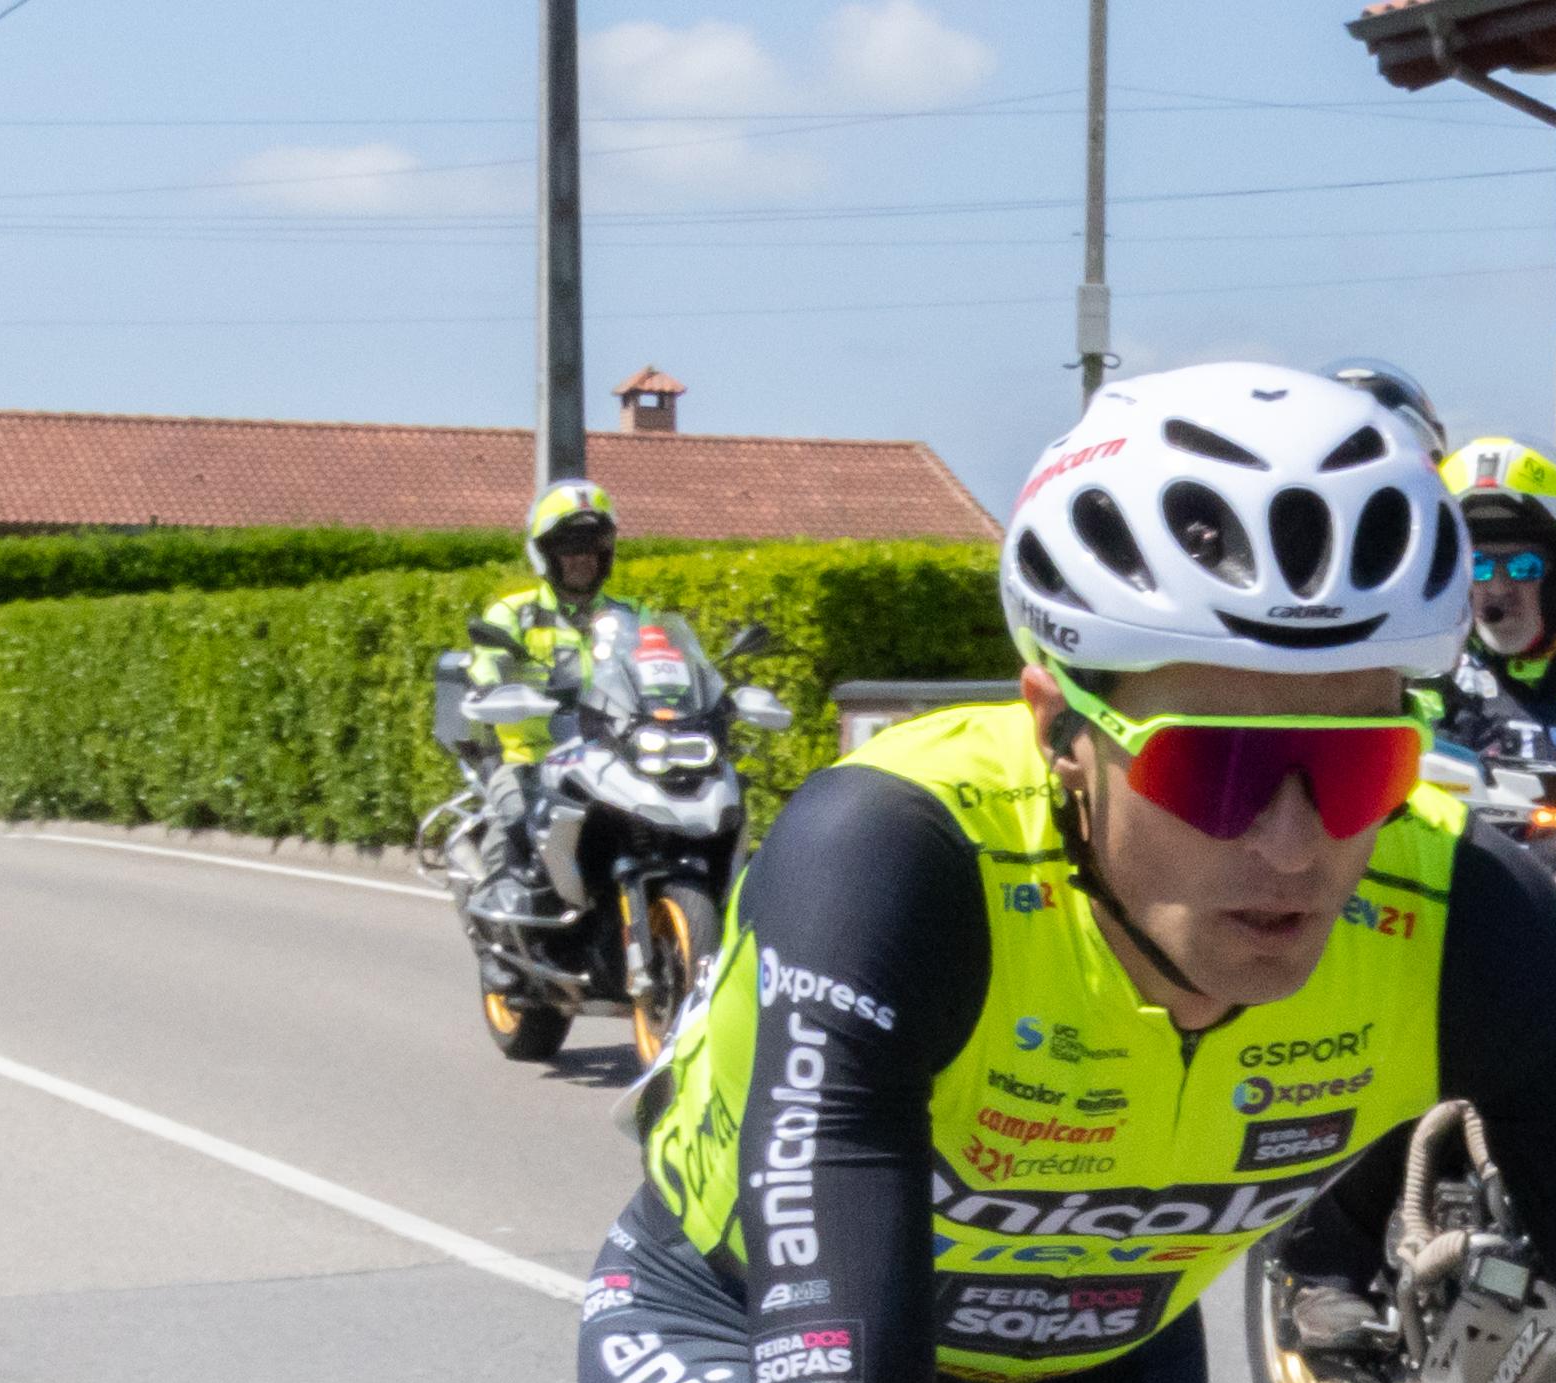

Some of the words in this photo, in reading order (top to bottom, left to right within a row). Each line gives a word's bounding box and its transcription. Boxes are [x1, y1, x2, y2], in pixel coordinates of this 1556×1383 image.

[749, 1010, 828, 1268] anicolor
[978, 1105, 1118, 1148] campicarn
[933, 1171, 1321, 1240] nicolo
[961, 1287, 1069, 1311] FEIRA
[946, 1306, 1140, 1343] SOFAS
[755, 1334, 804, 1361] FEIRA
